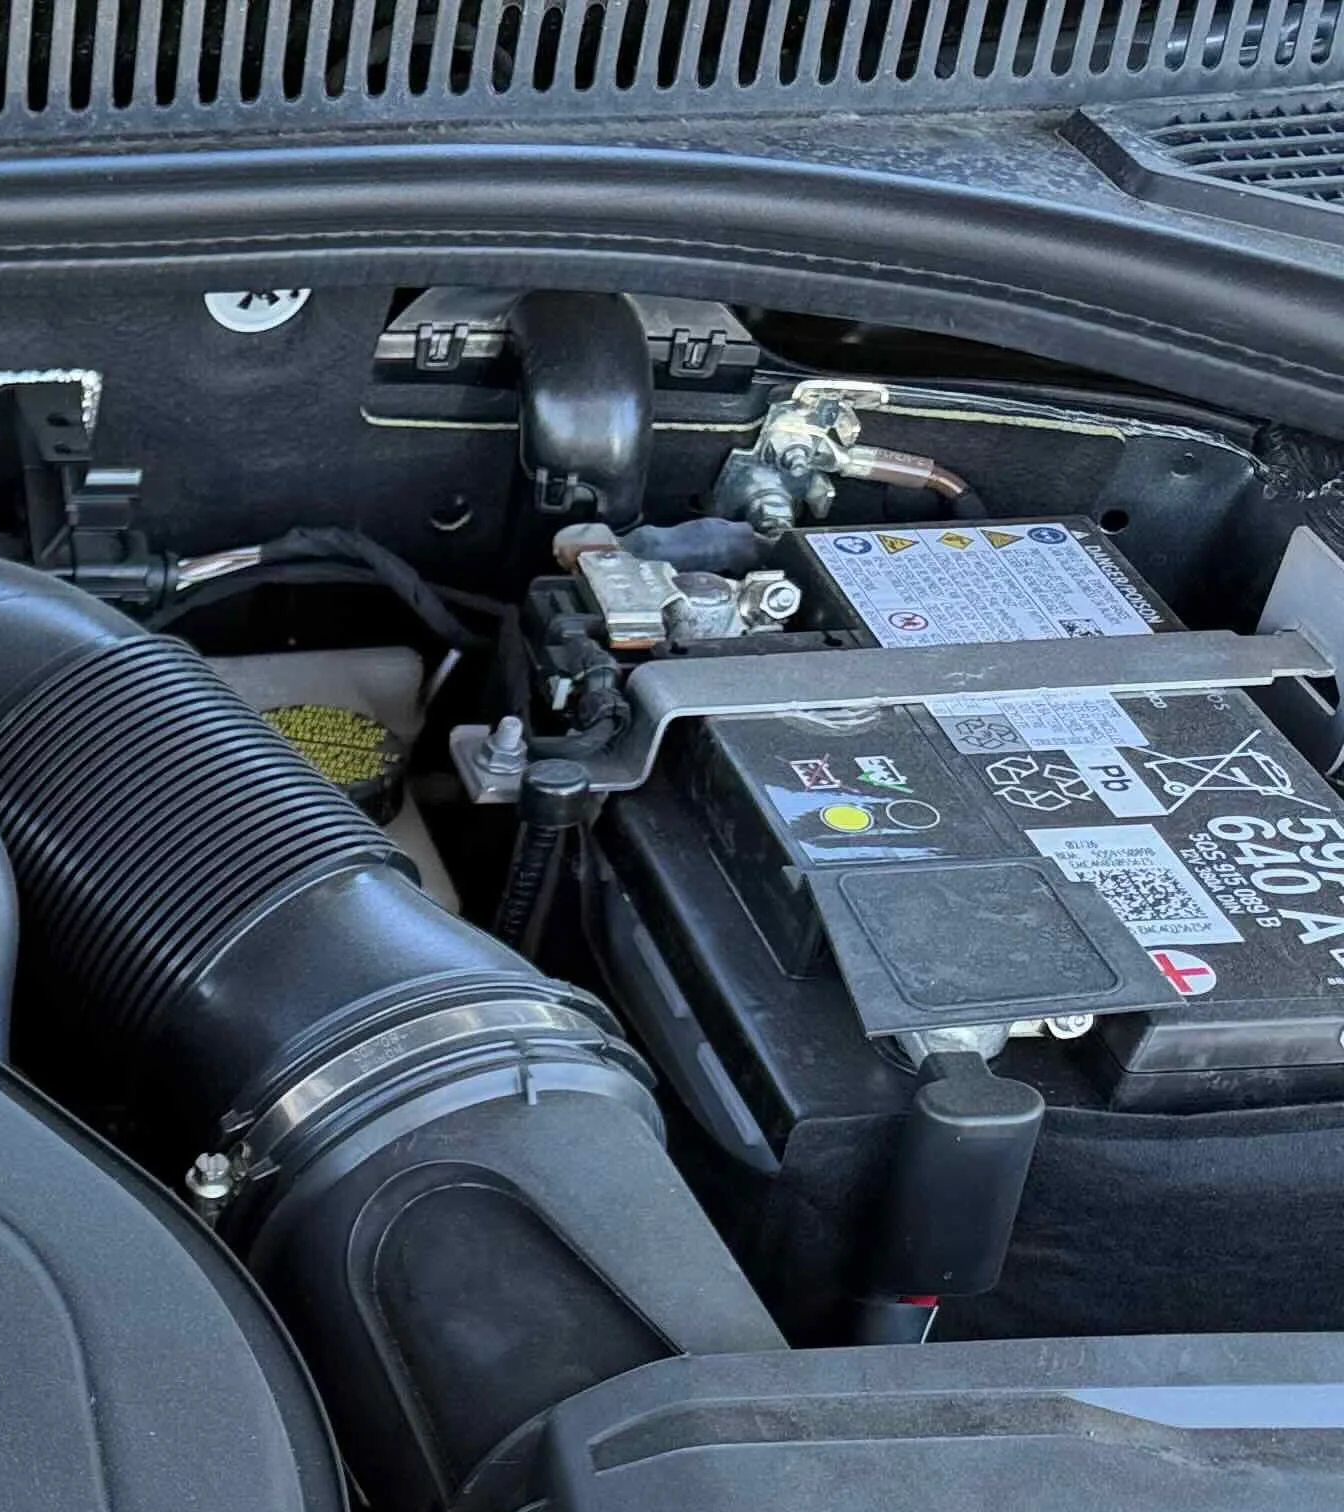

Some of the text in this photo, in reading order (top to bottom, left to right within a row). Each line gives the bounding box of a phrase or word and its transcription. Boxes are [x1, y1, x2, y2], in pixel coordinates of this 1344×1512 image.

[1084, 545, 1166, 624] DANGER/POISON
[1090, 764, 1133, 793] Pb
[1189, 833, 1282, 928] 5QS 915 089 B
[1206, 815, 1344, 945] 640 A
[1216, 894, 1245, 914] DIN
